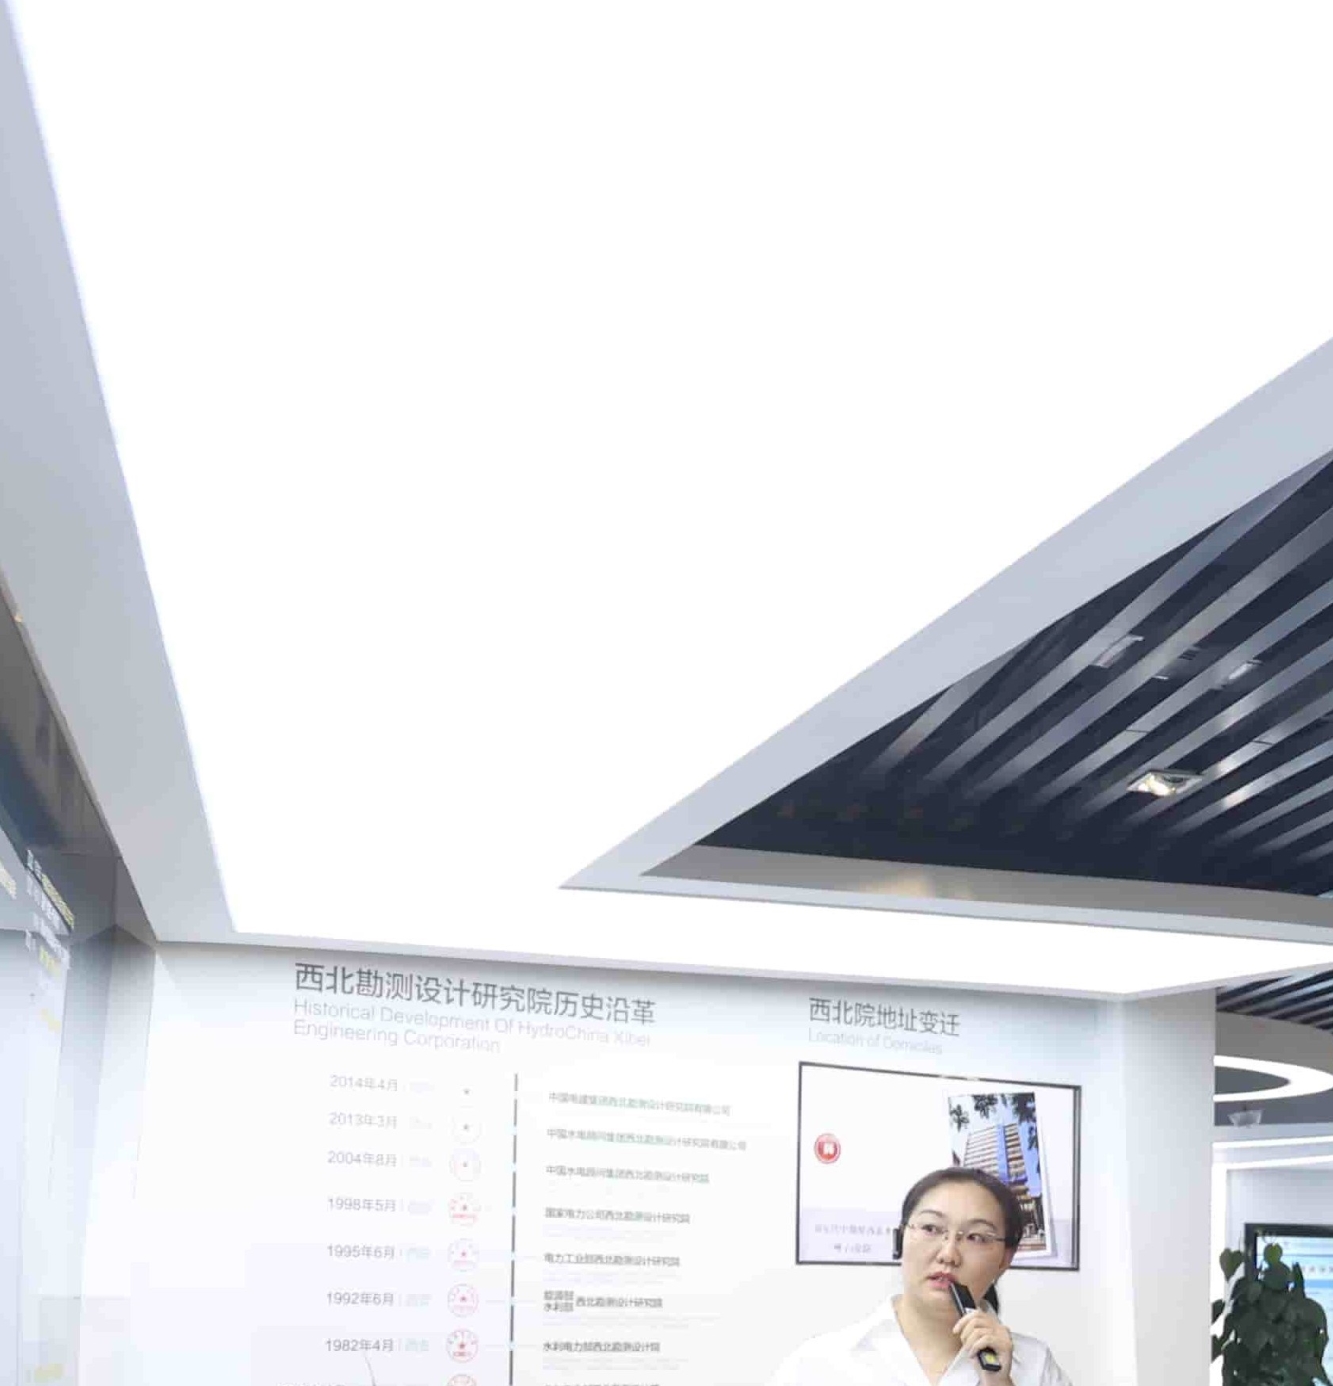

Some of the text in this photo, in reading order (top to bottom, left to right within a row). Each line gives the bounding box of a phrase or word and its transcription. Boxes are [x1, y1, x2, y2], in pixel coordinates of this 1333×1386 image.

[295, 962, 656, 1026] 西北勘测设计研究院历史沿革
[294, 998, 375, 1022] Historical
[380, 1006, 490, 1033] Development
[518, 1020, 609, 1044] HydroChina
[809, 997, 961, 1037] 西北院地址变迁
[294, 1019, 501, 1054] Engineering Corporation
[327, 1197, 397, 1213] 1998年5月
[325, 1291, 395, 1307] 1992年6月
[325, 1337, 395, 1352] 1982年4月
